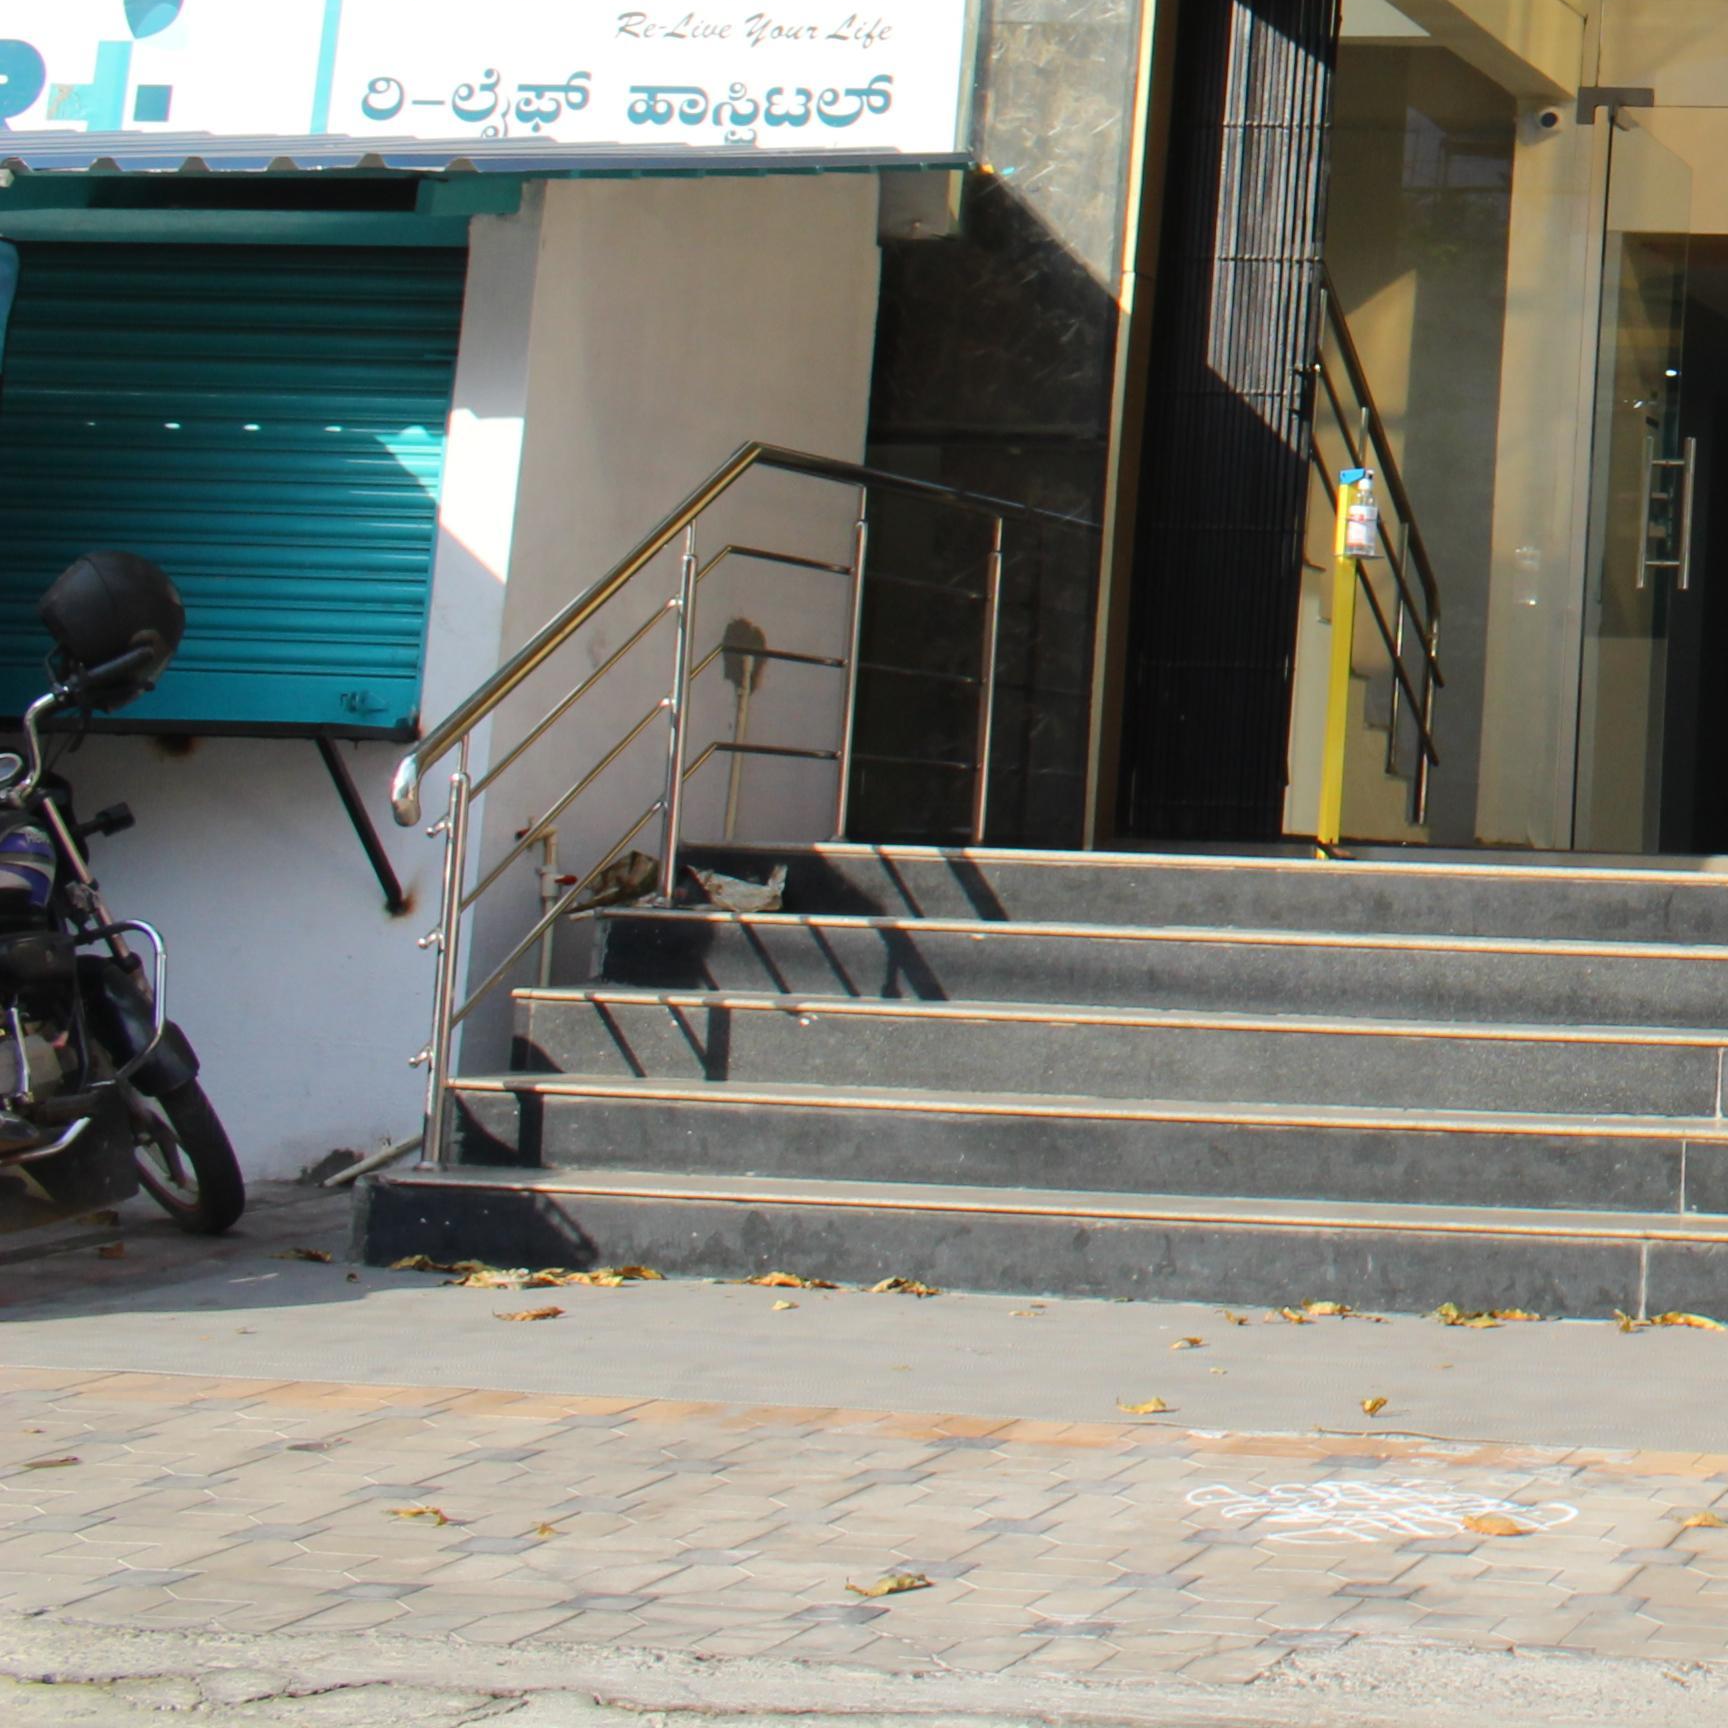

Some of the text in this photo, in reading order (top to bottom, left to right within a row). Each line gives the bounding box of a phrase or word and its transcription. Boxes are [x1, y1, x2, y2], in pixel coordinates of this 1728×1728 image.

[615, 11, 893, 49] Re-Live Your Life
